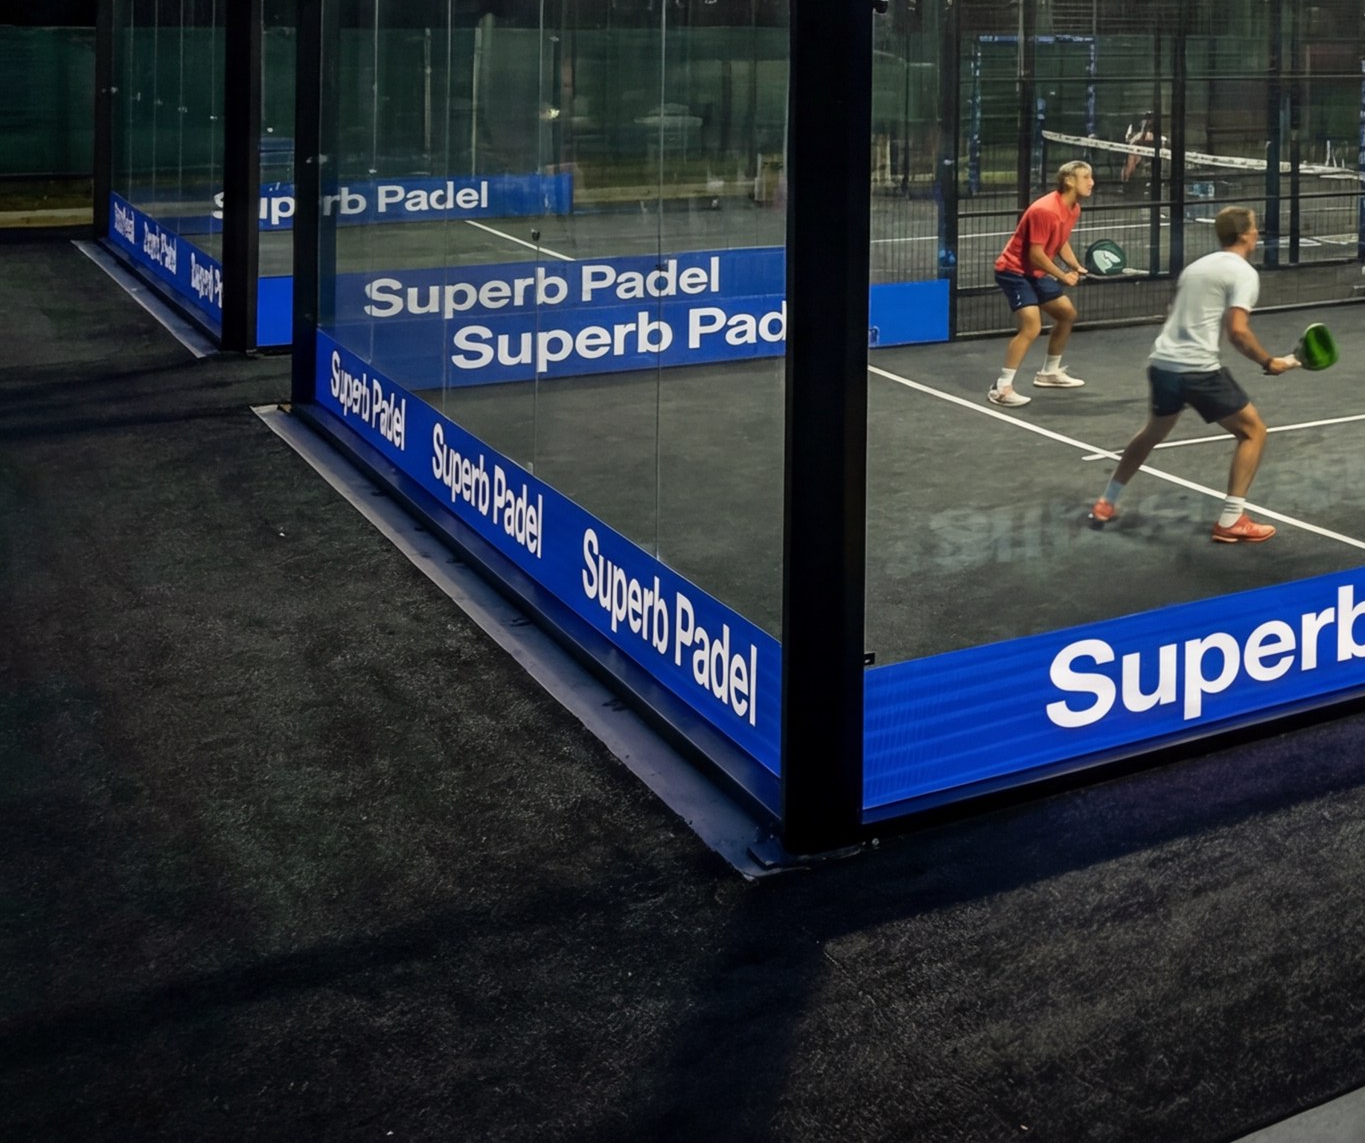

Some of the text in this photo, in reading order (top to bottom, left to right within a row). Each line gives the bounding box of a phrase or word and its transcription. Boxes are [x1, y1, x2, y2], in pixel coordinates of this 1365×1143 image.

[377, 180, 489, 213] Padel
[364, 256, 720, 320] Superb Padel
[451, 312, 673, 373] Superb
[330, 349, 406, 451] Superb Padel
[432, 423, 544, 559] Superb Padel
[582, 528, 758, 726] Superb Padel
